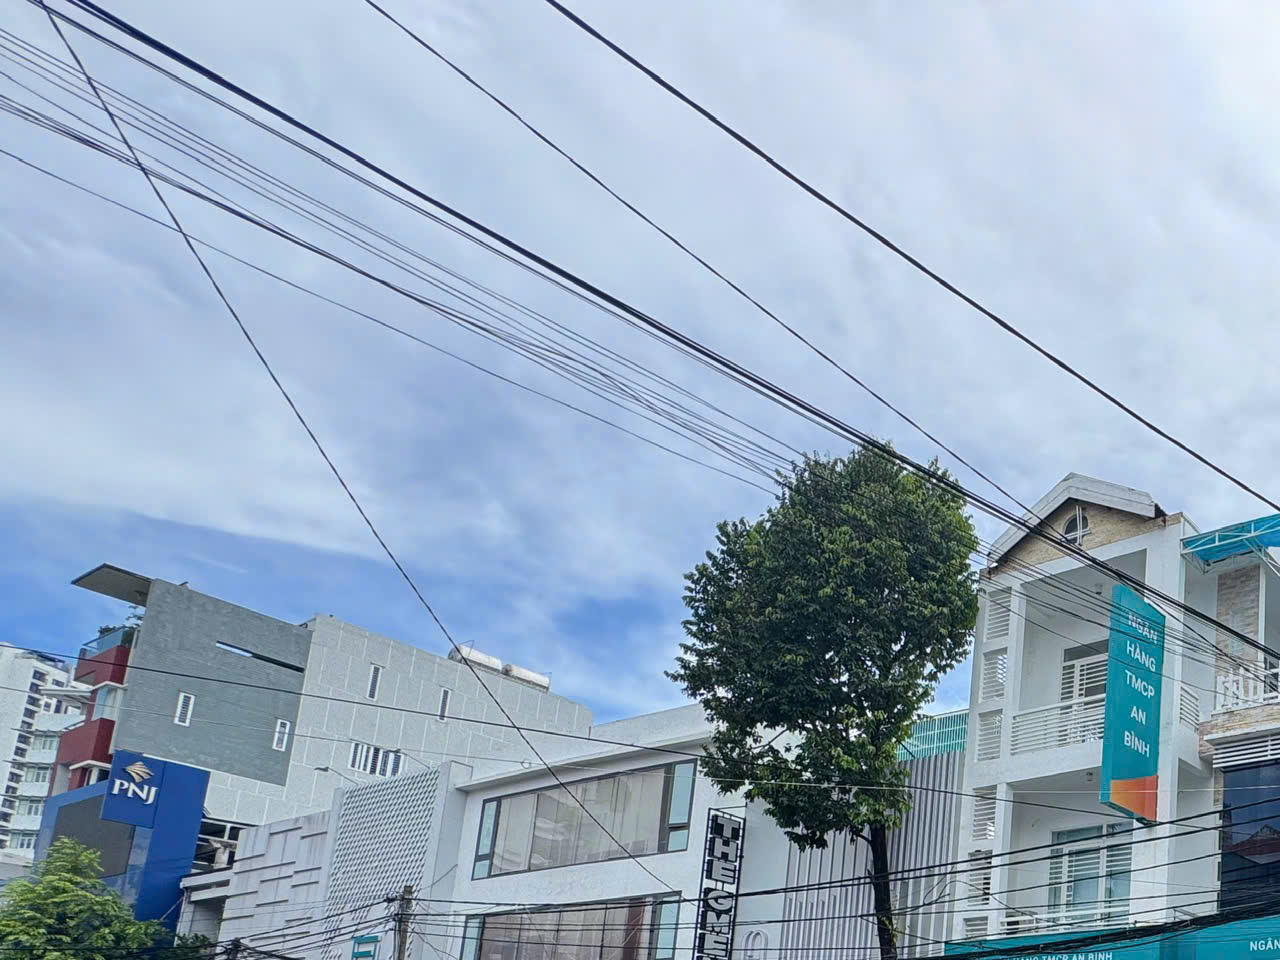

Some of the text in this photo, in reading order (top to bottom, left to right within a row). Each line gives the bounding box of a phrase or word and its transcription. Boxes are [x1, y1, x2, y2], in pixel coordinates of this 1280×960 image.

[1128, 613, 1158, 644] NGÂN
[1126, 640, 1156, 672] HÀNG
[1125, 669, 1155, 699] TMCP
[1131, 706, 1147, 725] AN
[1124, 730, 1150, 757] BÌNH
[112, 779, 158, 805] PNJ
[710, 816, 741, 885] THE
